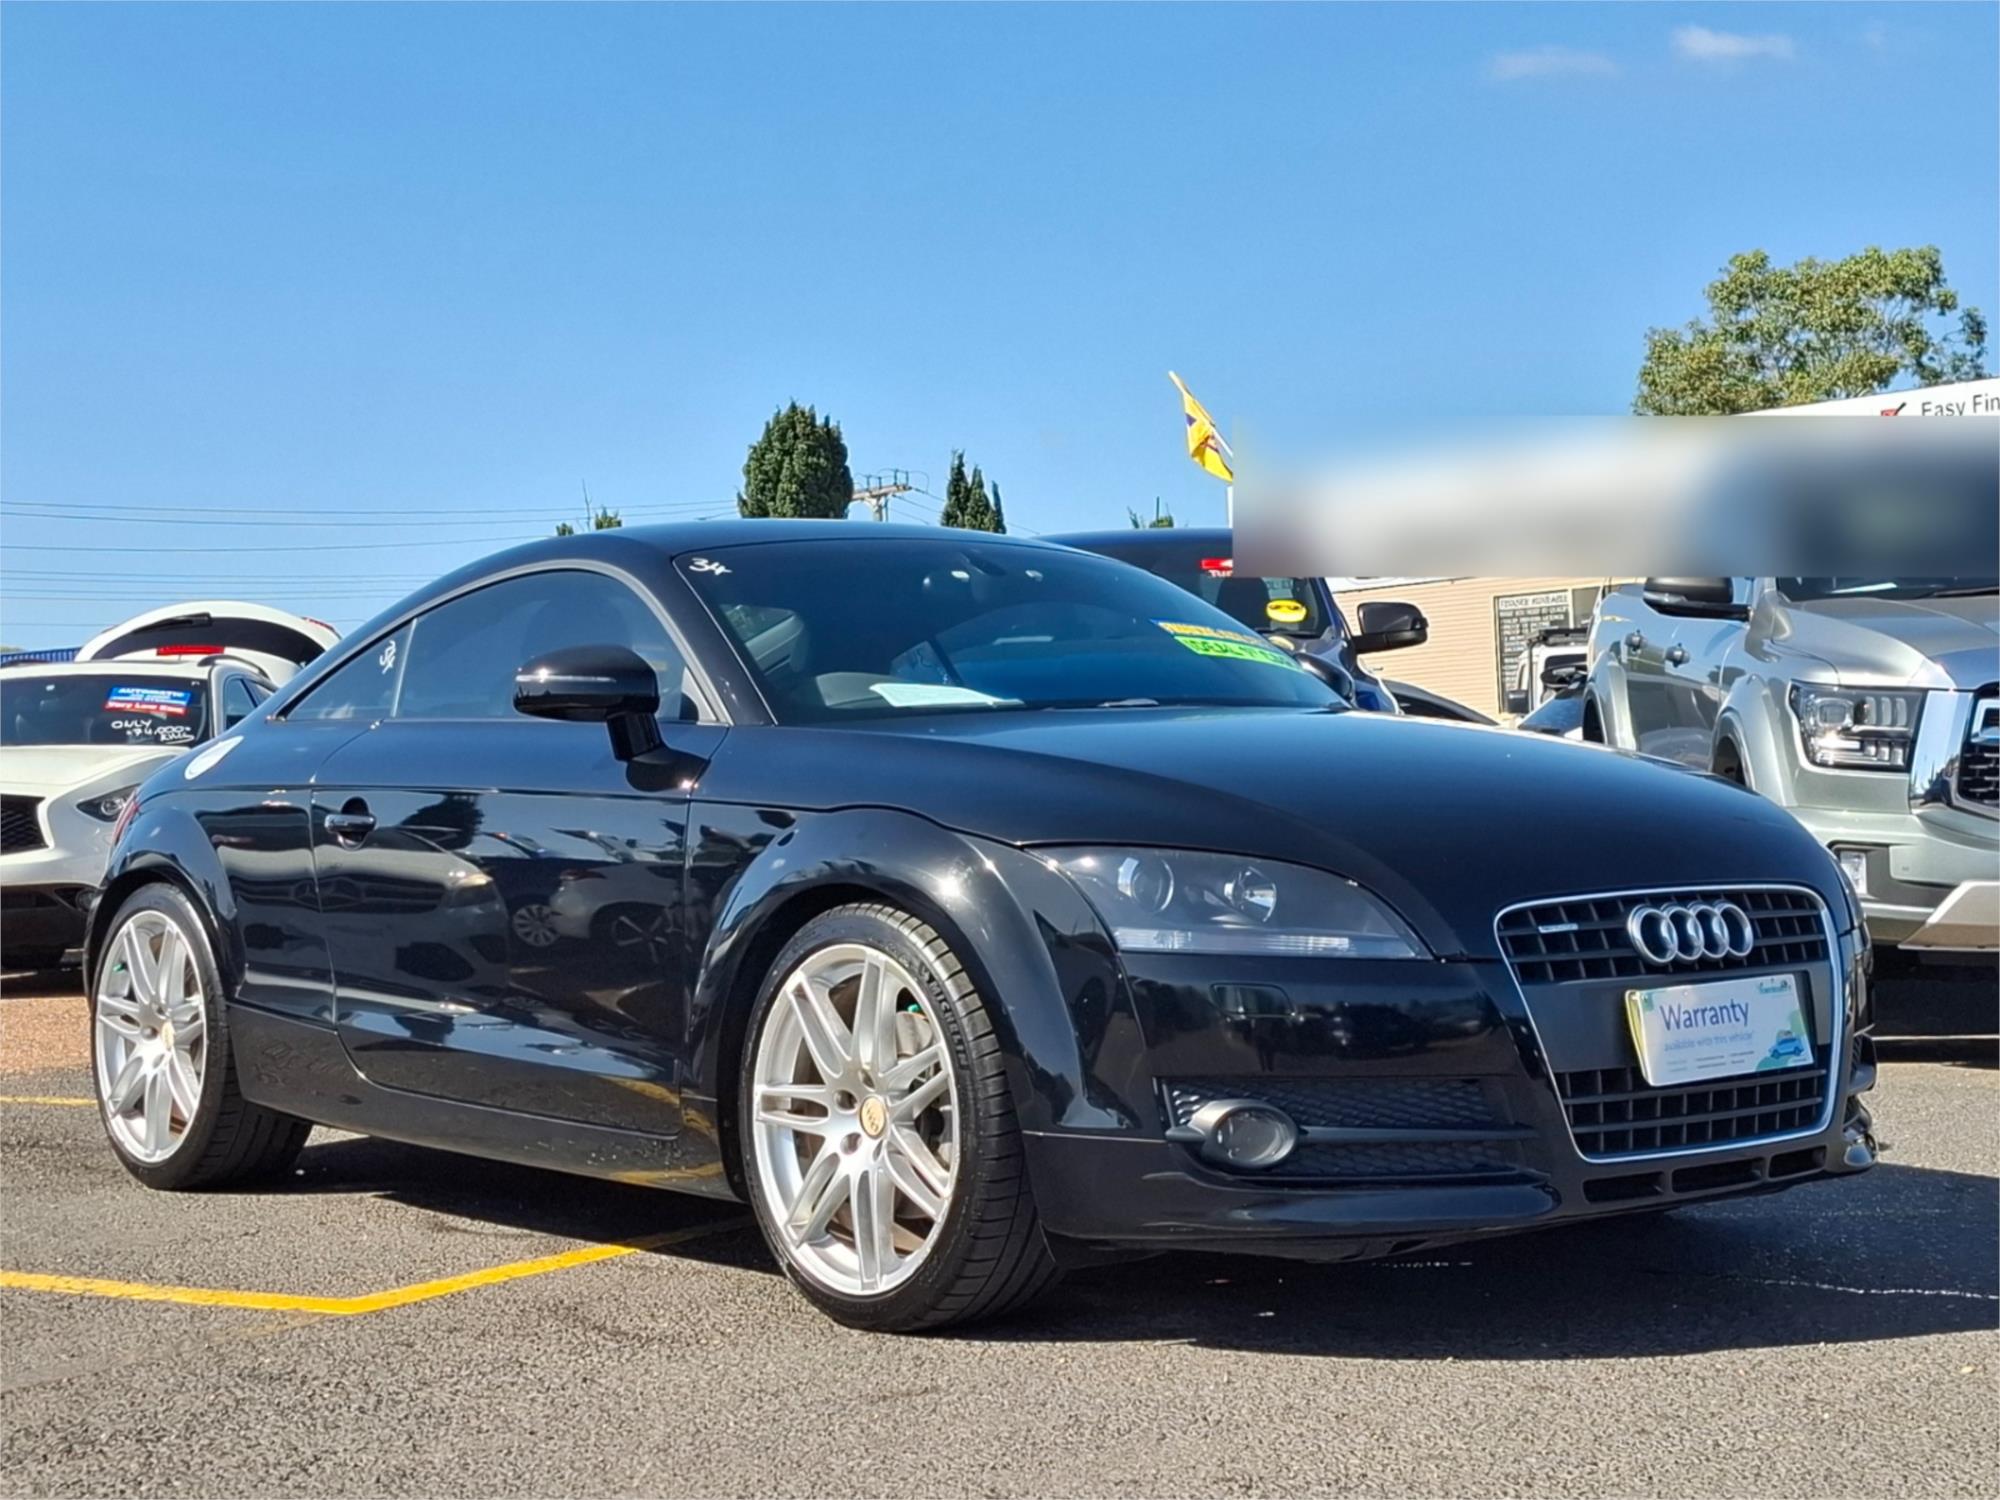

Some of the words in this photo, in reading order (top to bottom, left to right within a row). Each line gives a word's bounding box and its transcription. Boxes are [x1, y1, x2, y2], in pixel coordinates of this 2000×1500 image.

[1921, 401, 1966, 416] Easy
[689, 557, 732, 576] 34
[111, 720, 152, 729] ONLY
[1660, 998, 1749, 1031] Warranty
